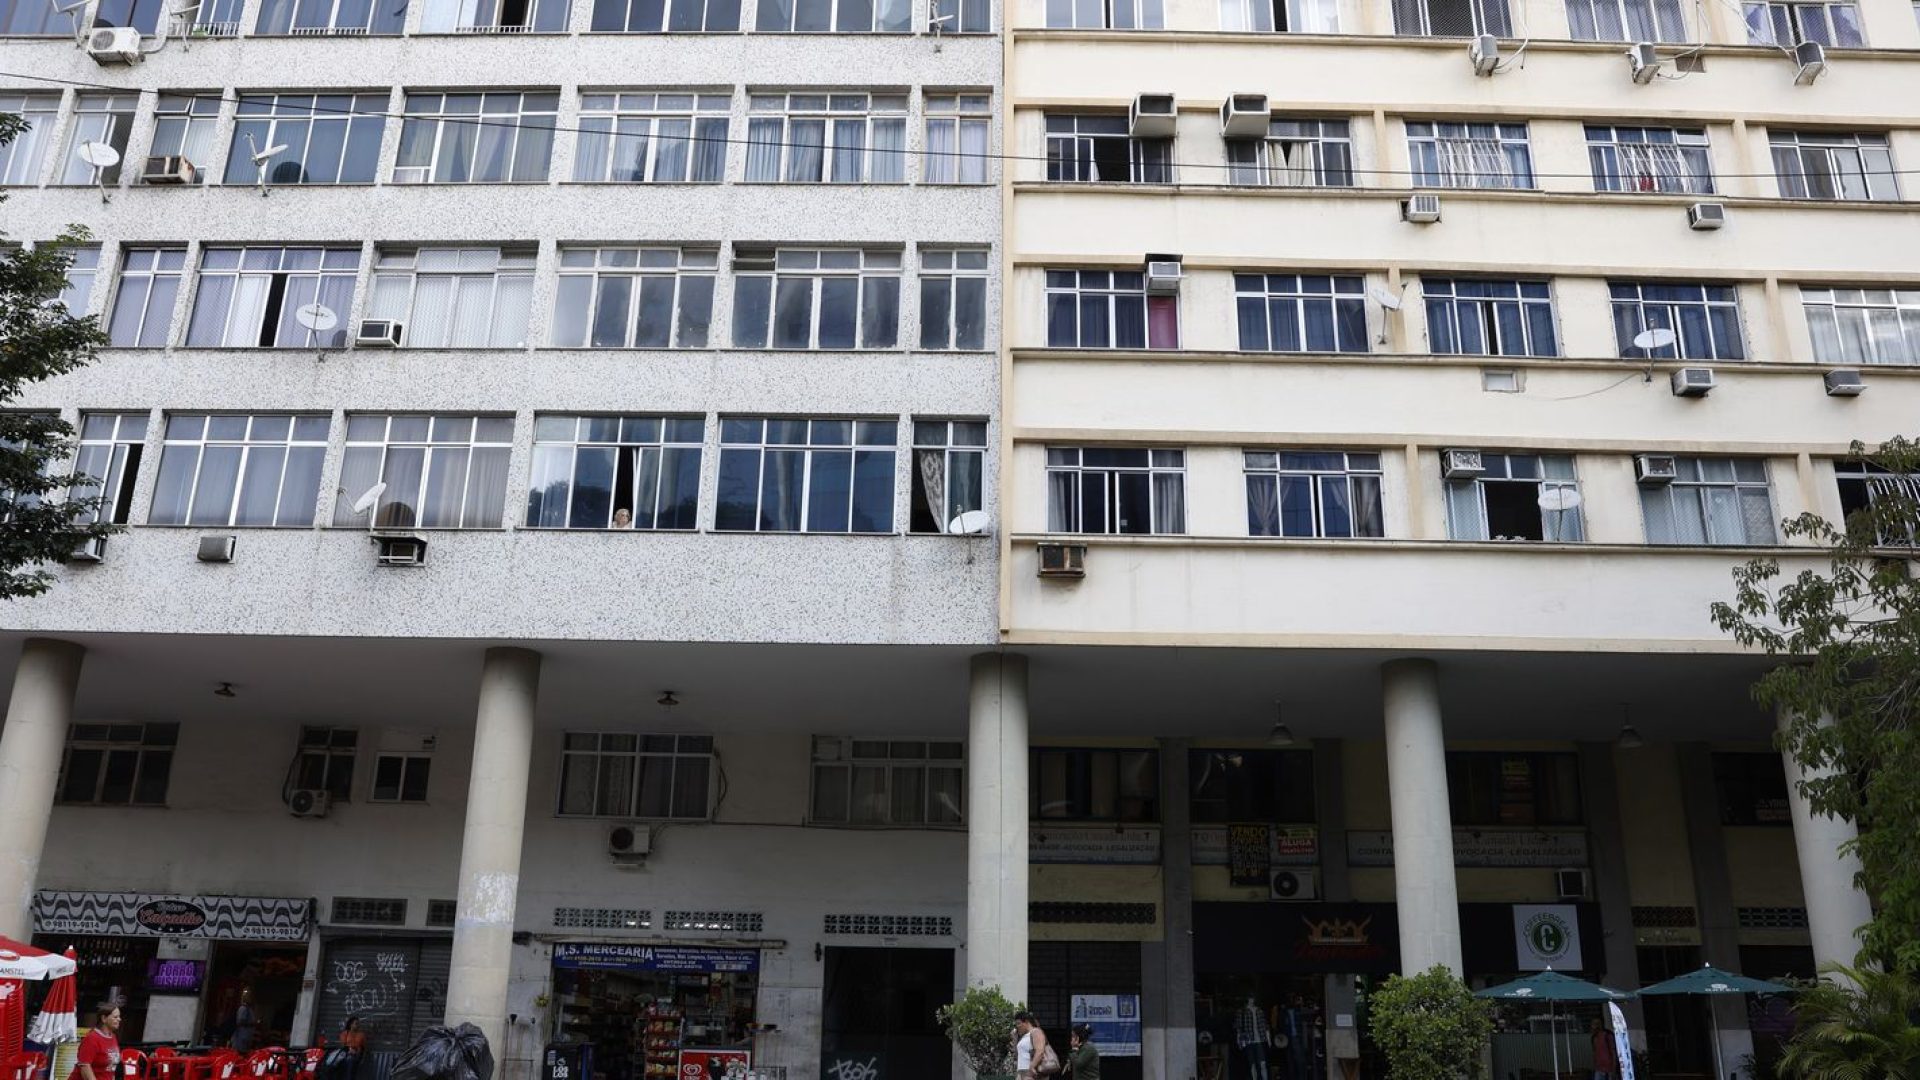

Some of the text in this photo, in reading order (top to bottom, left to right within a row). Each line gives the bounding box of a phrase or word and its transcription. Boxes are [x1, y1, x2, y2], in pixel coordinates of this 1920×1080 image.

[250, 926, 299, 935] 98119-9814
[555, 943, 580, 958] M.S.
[583, 945, 654, 961] MERCEARIA
